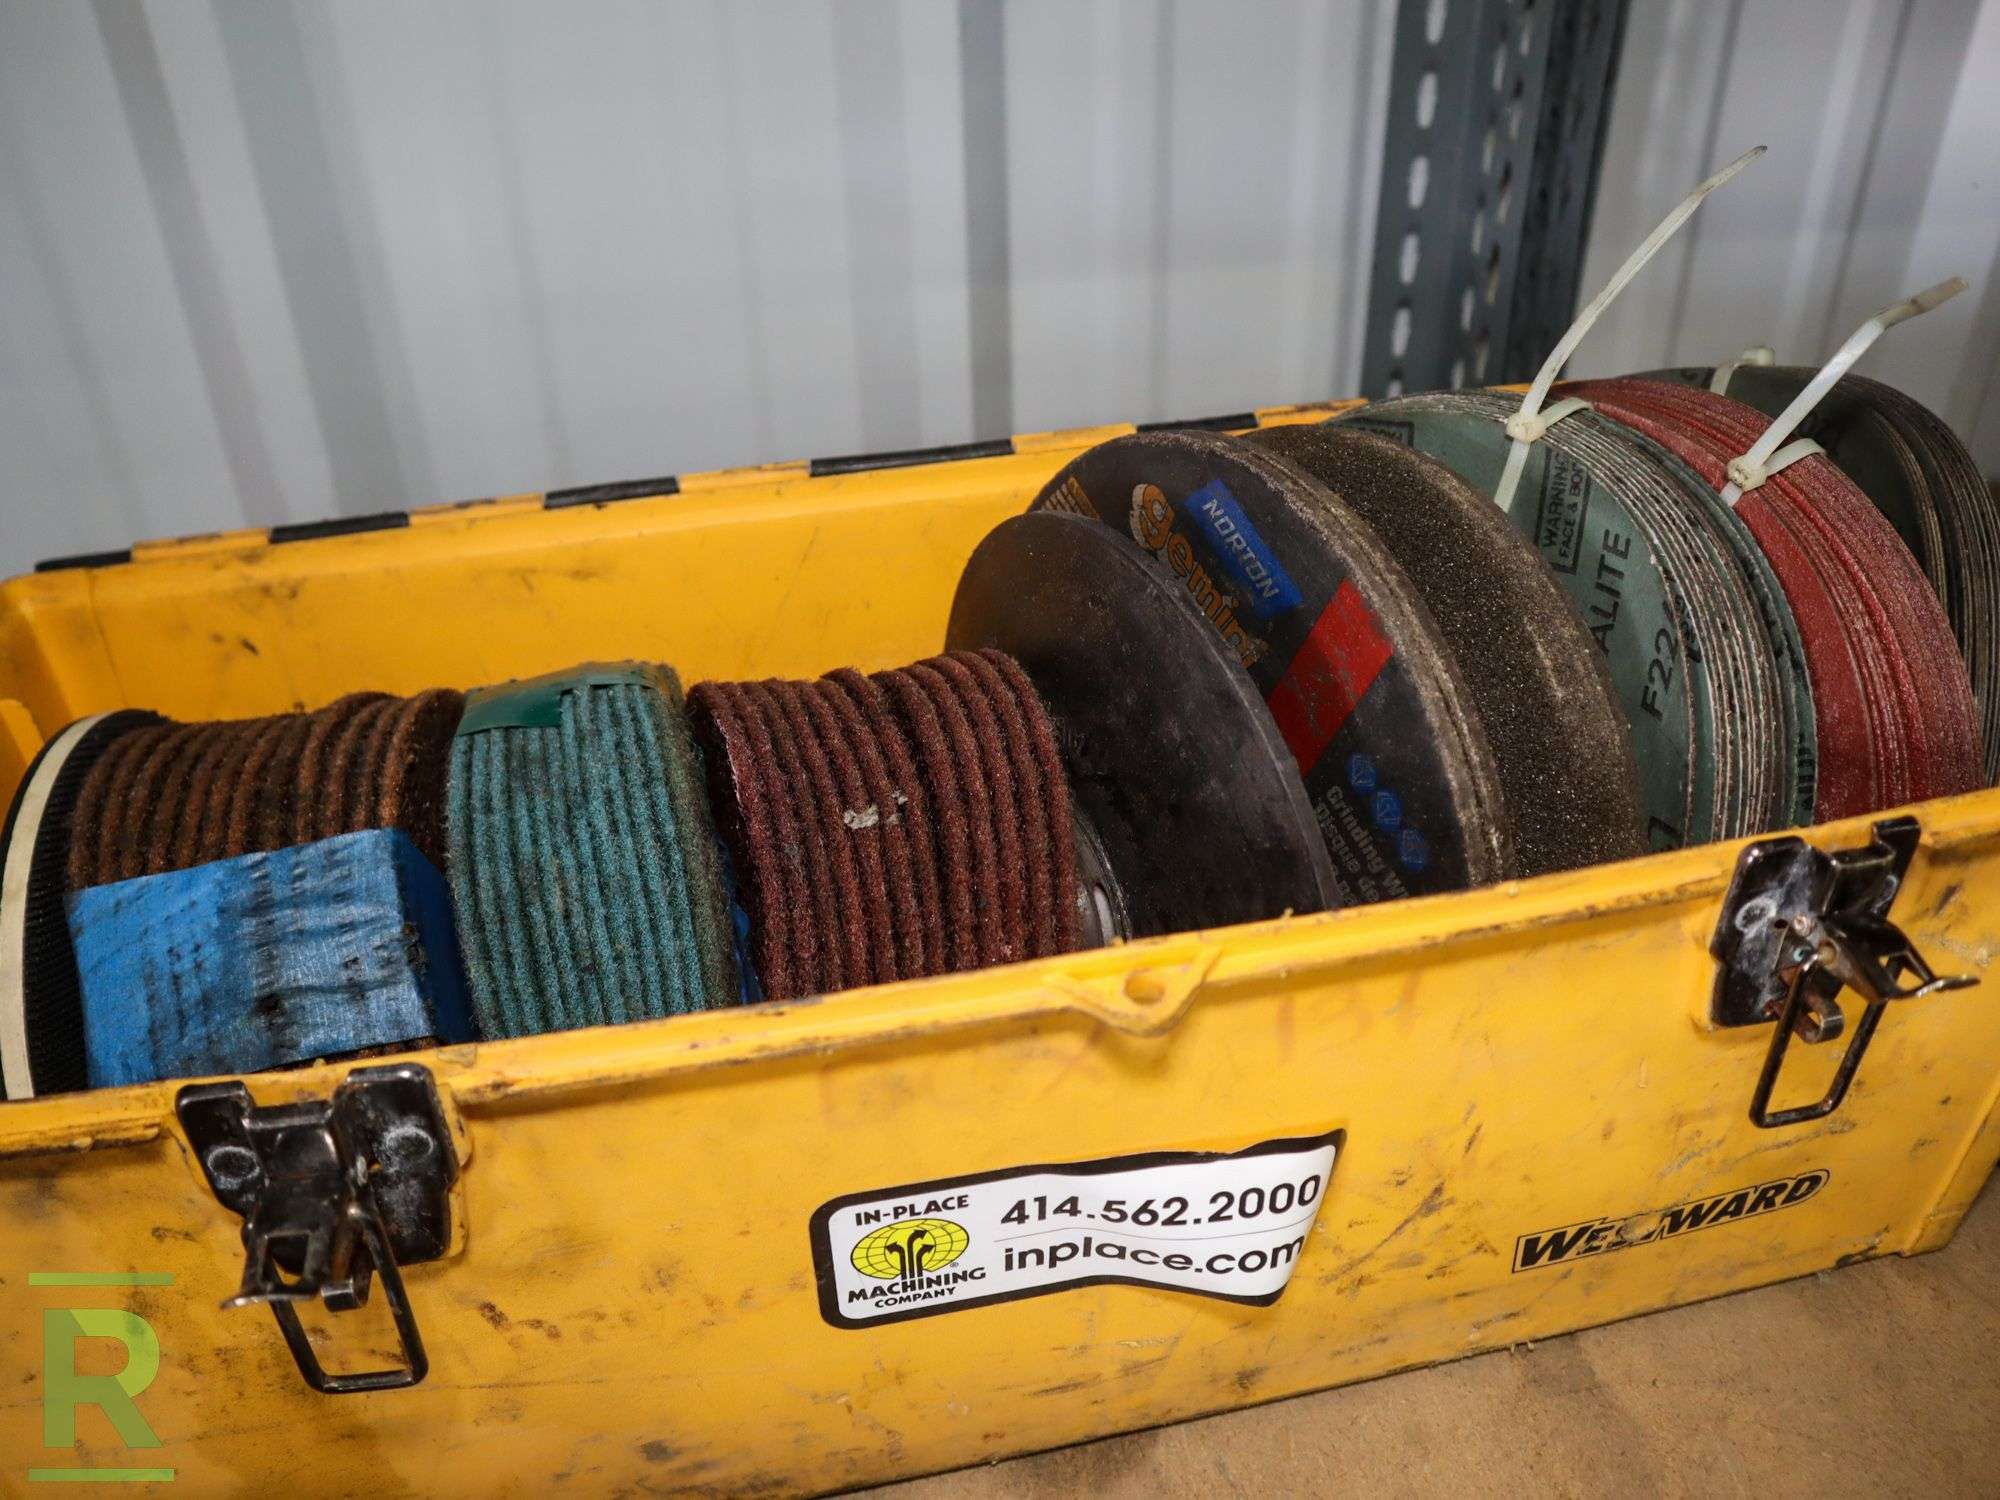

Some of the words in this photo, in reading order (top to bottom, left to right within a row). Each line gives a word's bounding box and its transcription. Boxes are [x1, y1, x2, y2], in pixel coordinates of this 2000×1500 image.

[1201, 498, 1280, 599] NORTON
[1558, 519, 1577, 559] FACE
[1590, 528, 1632, 658] ALITE
[1326, 785, 1386, 874] Grinding
[855, 1194, 970, 1227] IN-PLACE
[1000, 1174, 1321, 1226] 414.562.2000
[1519, 1173, 1823, 1268] WEWARD
[1004, 1234, 1305, 1275] inplace.com
[847, 1266, 987, 1304] MACHINING
[874, 1286, 957, 1309] COMPANY
